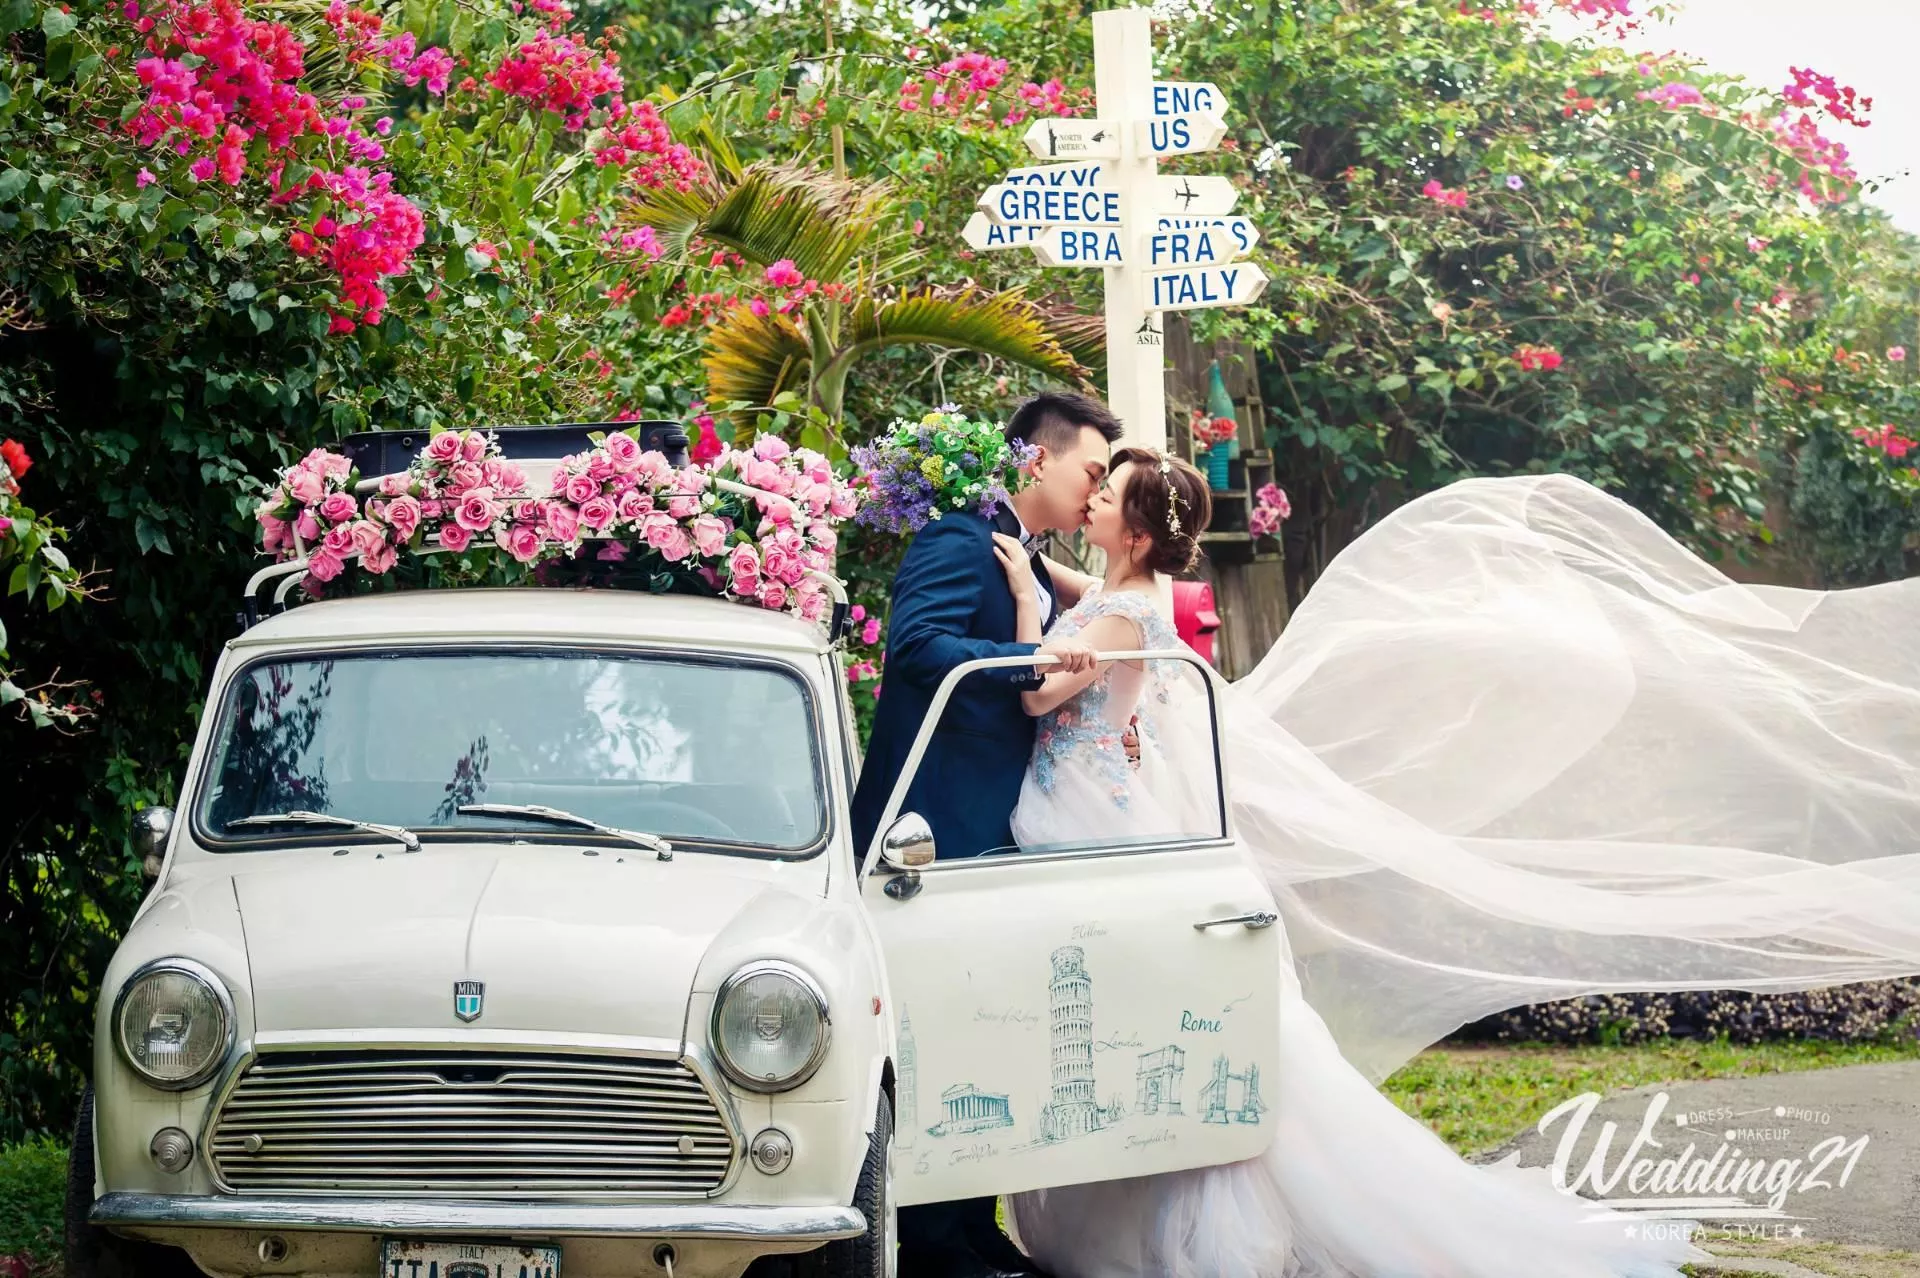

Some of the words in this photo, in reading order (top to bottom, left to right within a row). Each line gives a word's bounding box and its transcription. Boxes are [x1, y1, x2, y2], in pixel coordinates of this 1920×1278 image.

[1153, 86, 1212, 115] ENG
[1056, 143, 1088, 152] AMERICA
[1059, 133, 1083, 142] NORTH
[1150, 118, 1190, 152] US
[1000, 189, 1120, 222] GREECE
[1060, 231, 1123, 262] BRA
[1151, 232, 1215, 265] FRA
[1153, 268, 1239, 306] ITALY
[1136, 334, 1161, 345] ASIA
[458, 982, 480, 996] MINI
[1180, 1009, 1223, 1033] Rome
[459, 1245, 486, 1260] ITALY
